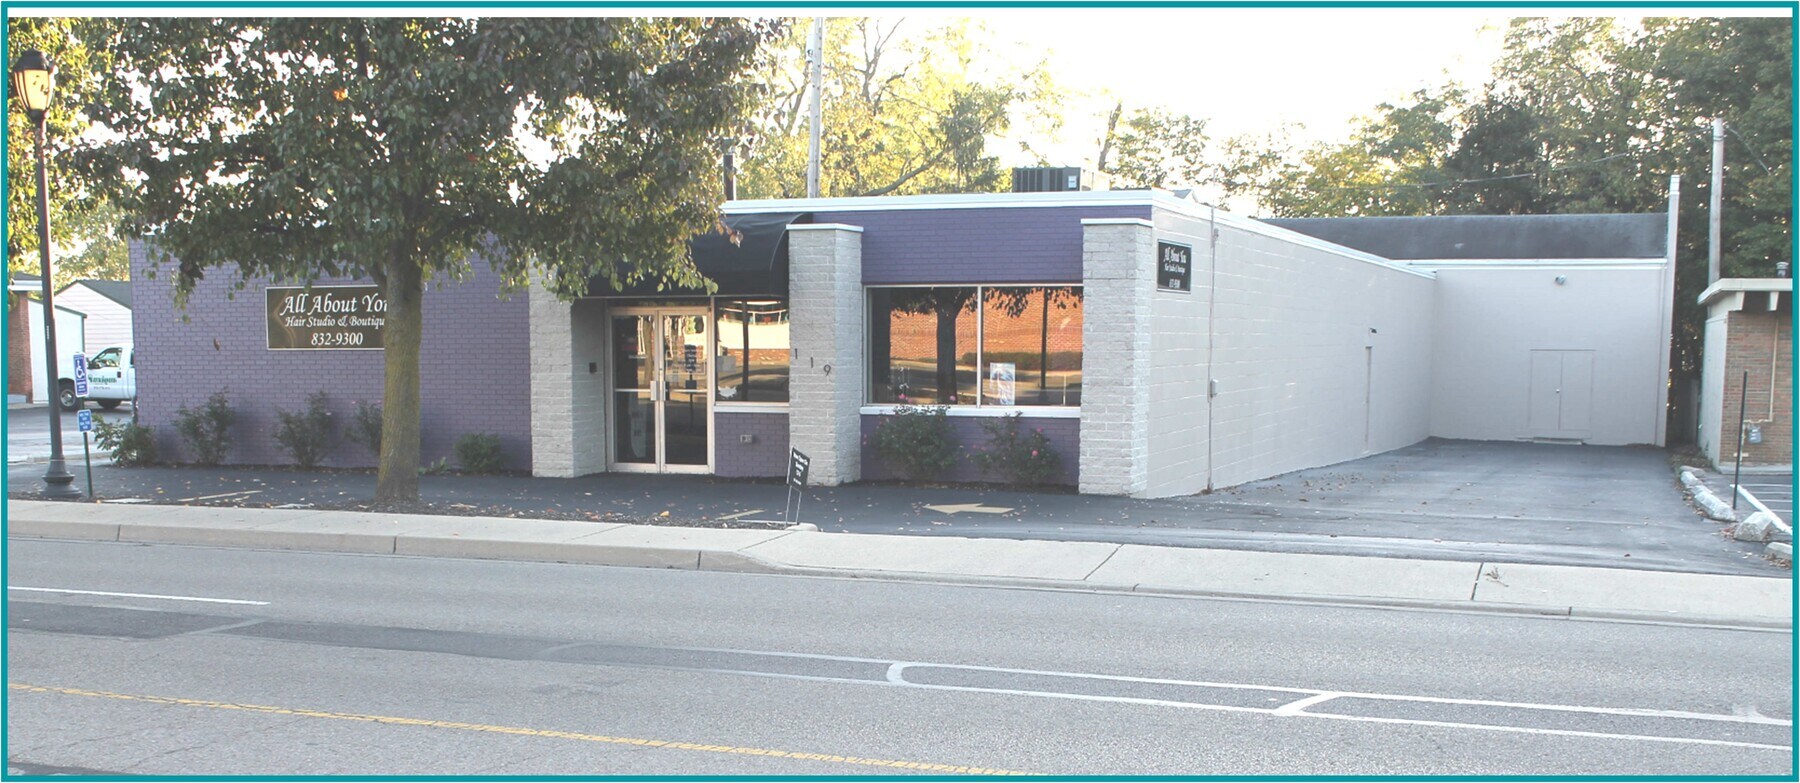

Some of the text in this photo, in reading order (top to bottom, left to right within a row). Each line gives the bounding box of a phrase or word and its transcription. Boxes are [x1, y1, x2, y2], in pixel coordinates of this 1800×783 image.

[280, 293, 309, 316] All
[307, 293, 357, 316] About
[285, 315, 385, 330] Hair Studio & Boutiqu
[311, 332, 364, 346] 832-9300
